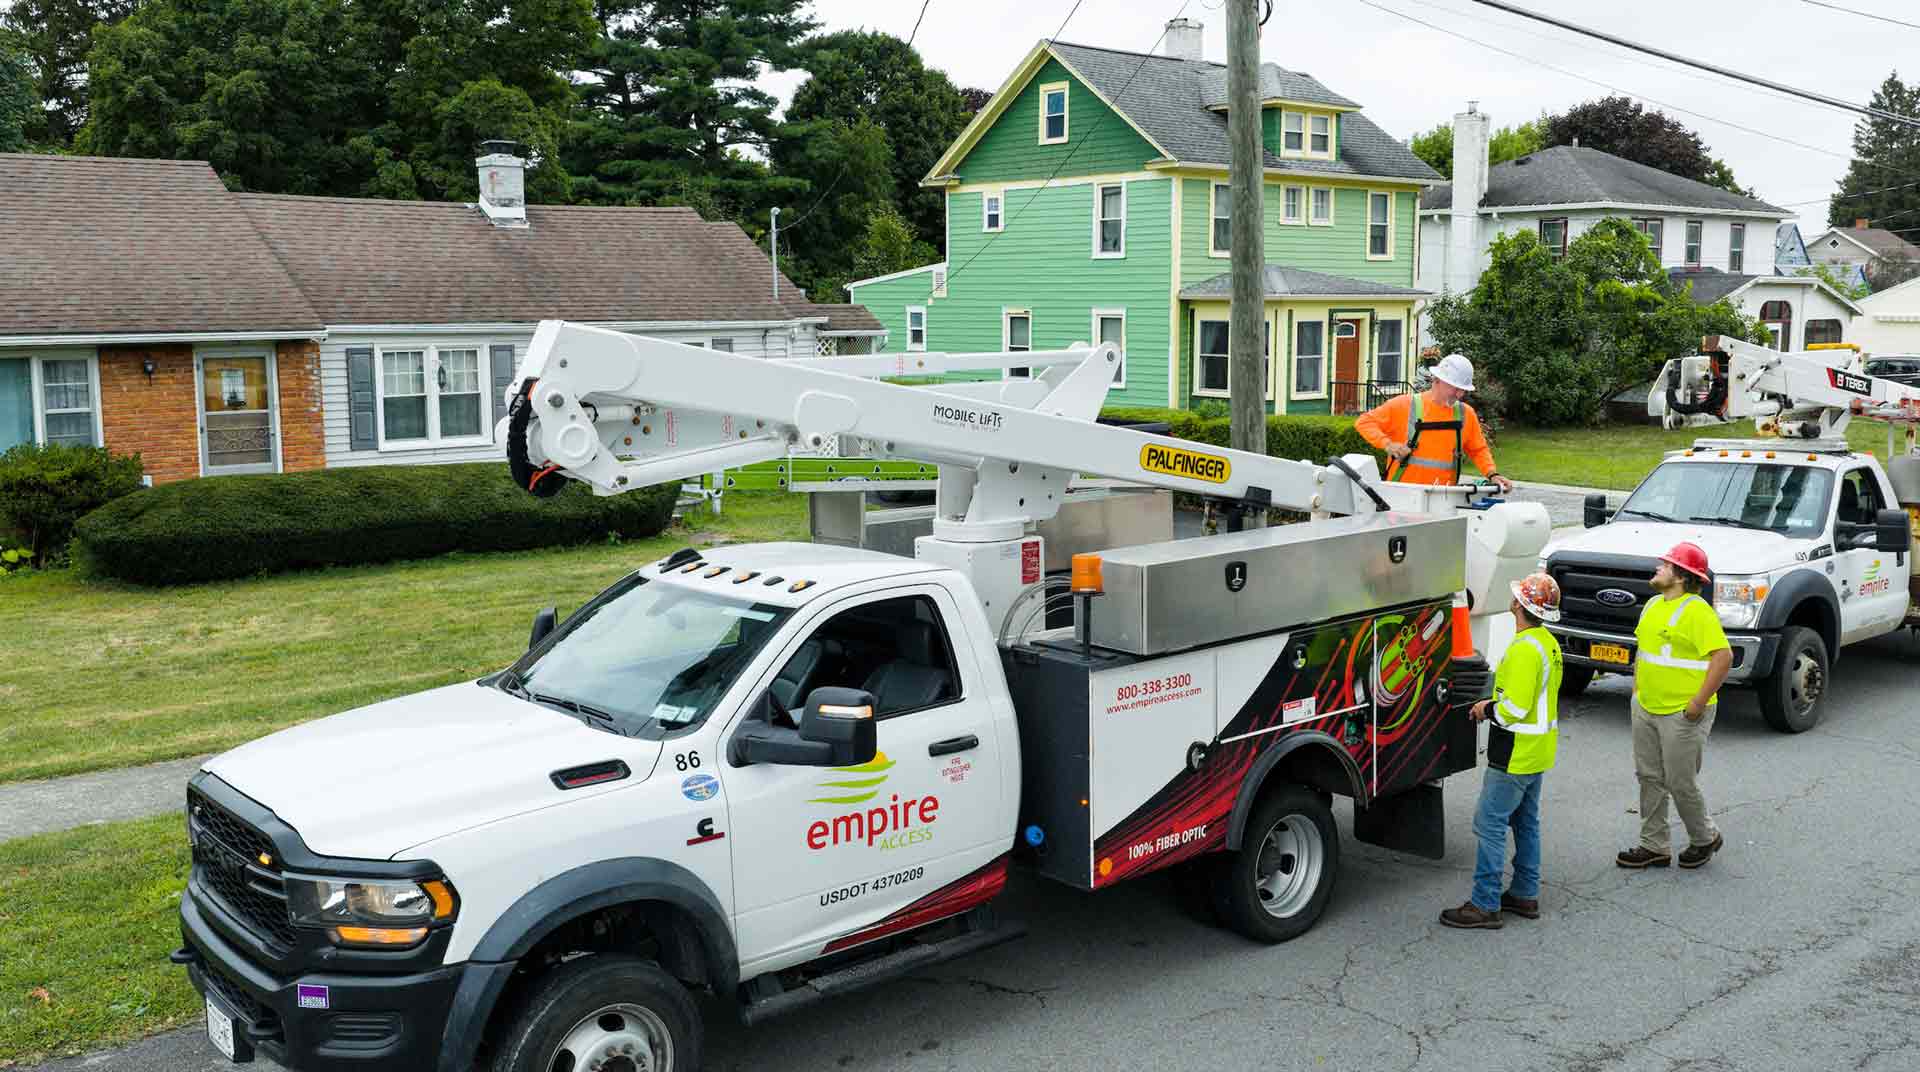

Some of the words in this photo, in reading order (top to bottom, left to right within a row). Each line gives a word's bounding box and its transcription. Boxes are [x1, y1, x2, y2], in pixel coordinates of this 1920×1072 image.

[1845, 376, 1869, 392] TEREX
[934, 405, 976, 424] MOBILE
[1146, 447, 1226, 480] PALFINGER
[1106, 687, 1202, 714] www.empireaccess.com
[1117, 673, 1192, 702] 800-338-3300
[675, 751, 701, 771] 86
[807, 794, 940, 850] empire
[880, 828, 934, 850] ACCESS
[1128, 840, 1154, 861] 100%
[1155, 832, 1181, 853] FIBER
[1182, 824, 1207, 844] OPTIC
[820, 882, 869, 907] USDOT
[872, 866, 924, 892] 4370209
